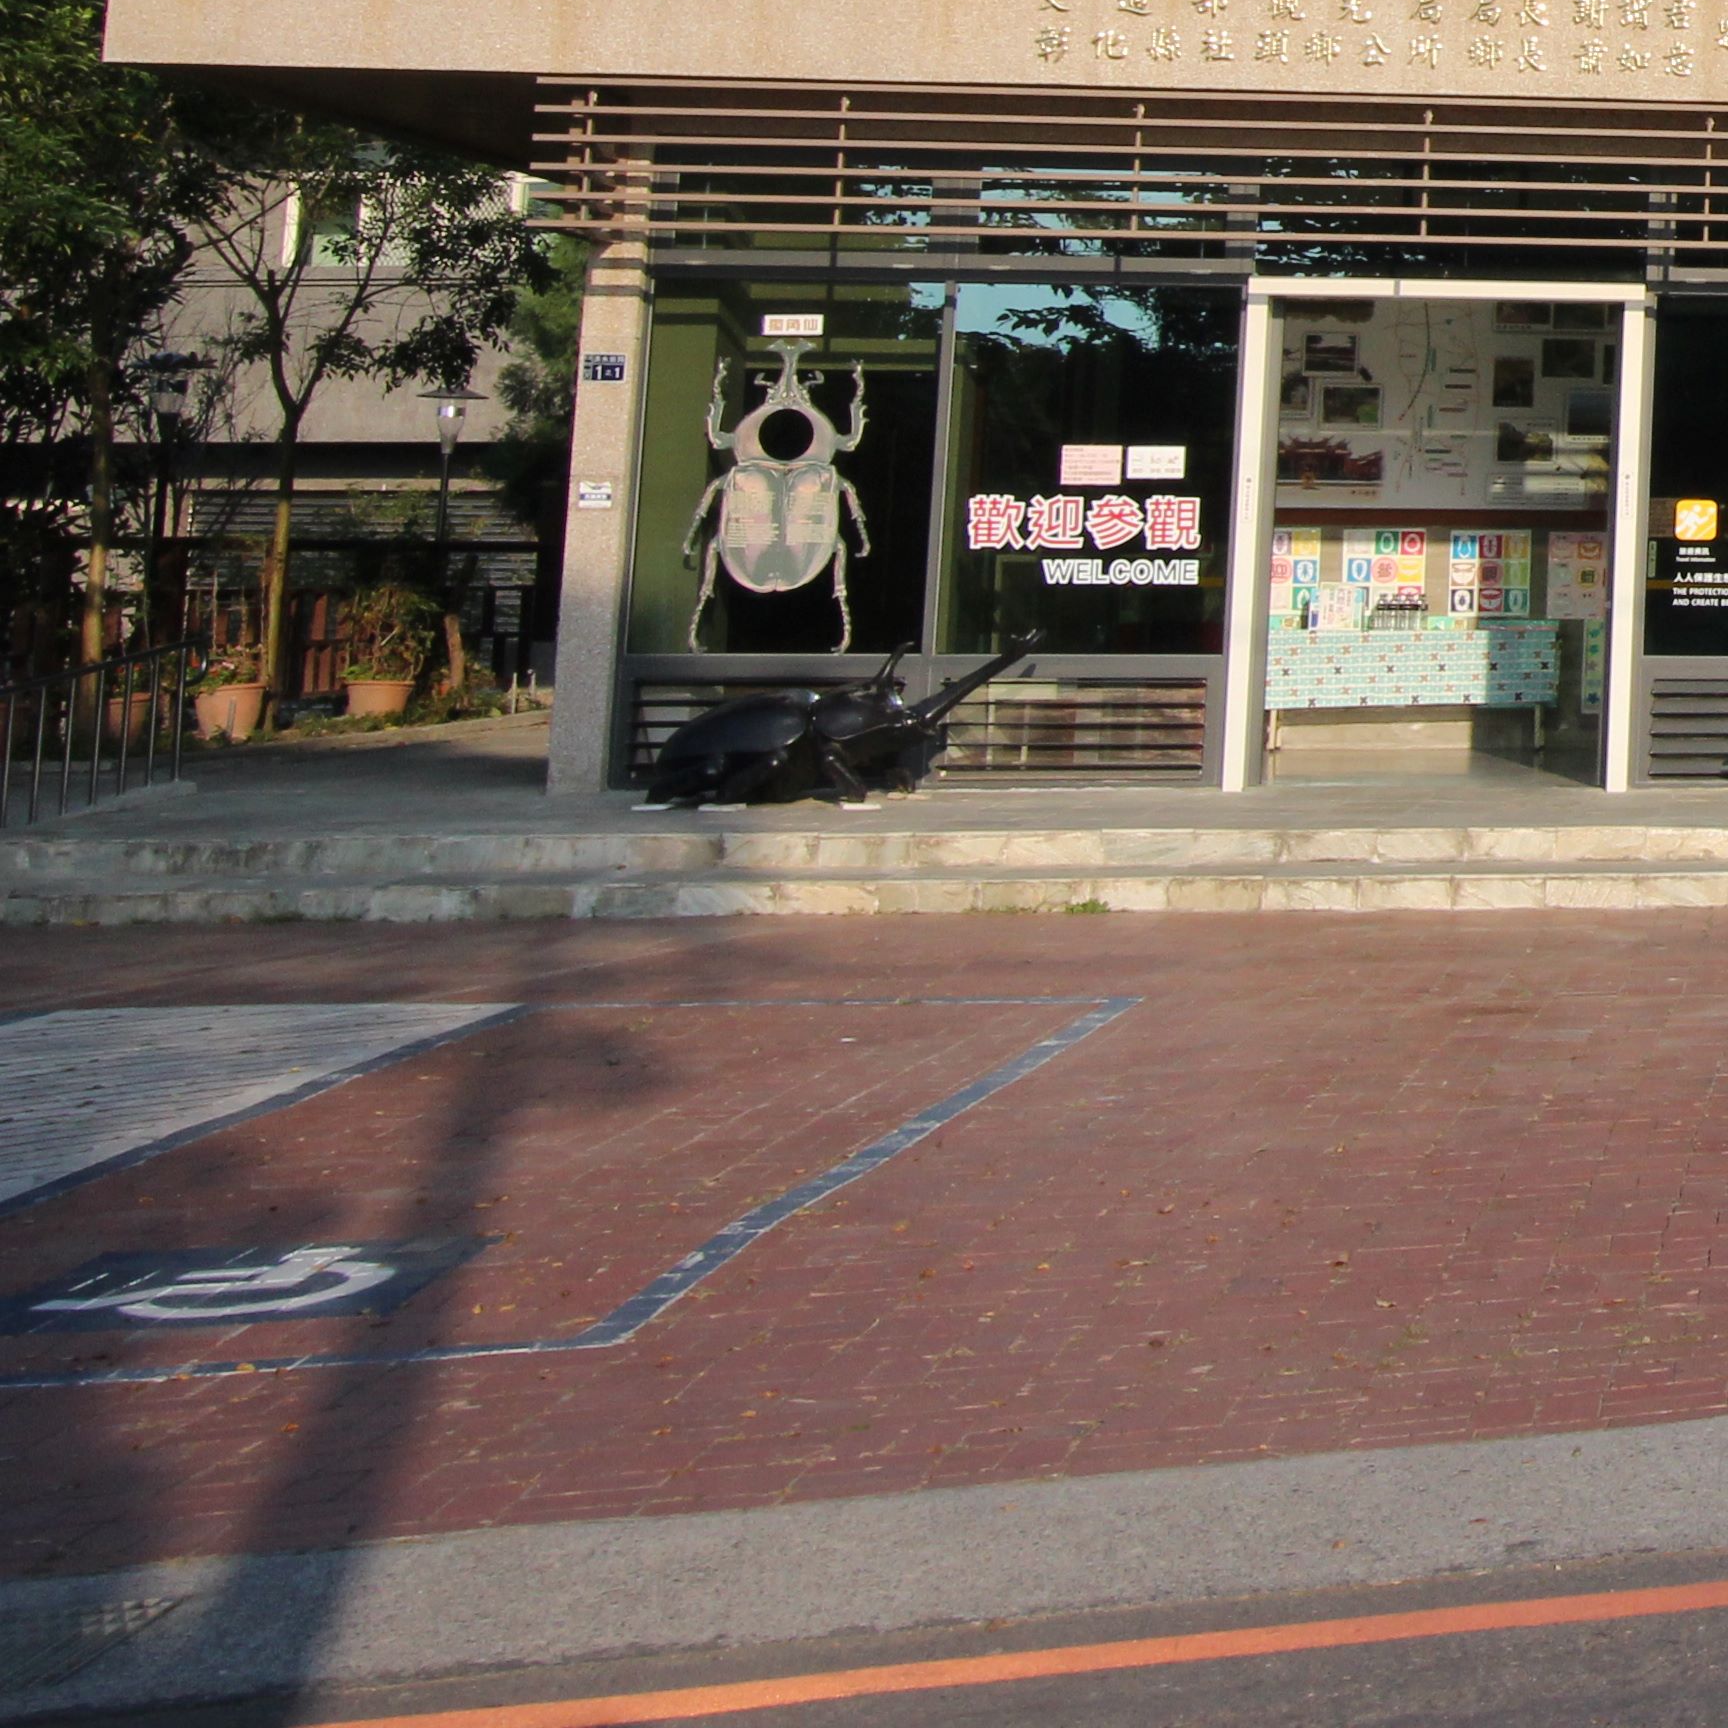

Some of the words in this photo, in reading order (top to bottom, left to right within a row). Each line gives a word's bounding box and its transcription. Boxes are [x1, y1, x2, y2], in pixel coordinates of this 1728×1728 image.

[967, 494, 1202, 550] 歡迎參觀
[1042, 558, 1200, 585] WELCOME
[1672, 587, 1687, 596] THE
[1672, 598, 1690, 606] AND
[1691, 598, 1719, 606] CREATE
